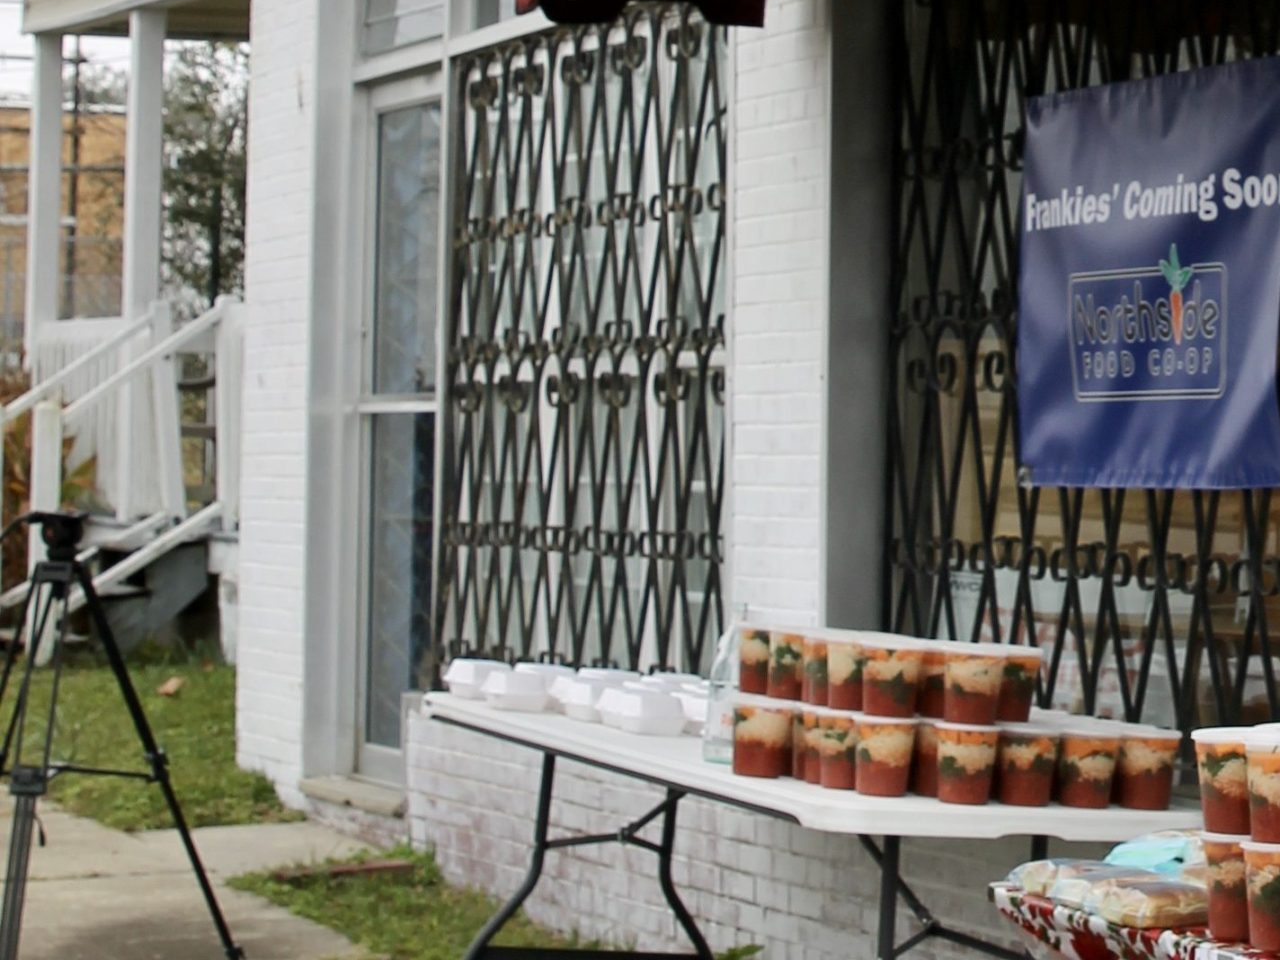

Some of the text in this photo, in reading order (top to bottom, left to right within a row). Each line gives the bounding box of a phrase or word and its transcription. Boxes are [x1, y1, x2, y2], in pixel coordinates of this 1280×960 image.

[1026, 183, 1120, 231] Frankies'
[1123, 173, 1219, 221] Coming
[1082, 346, 1213, 379] FOOD CO-OP
